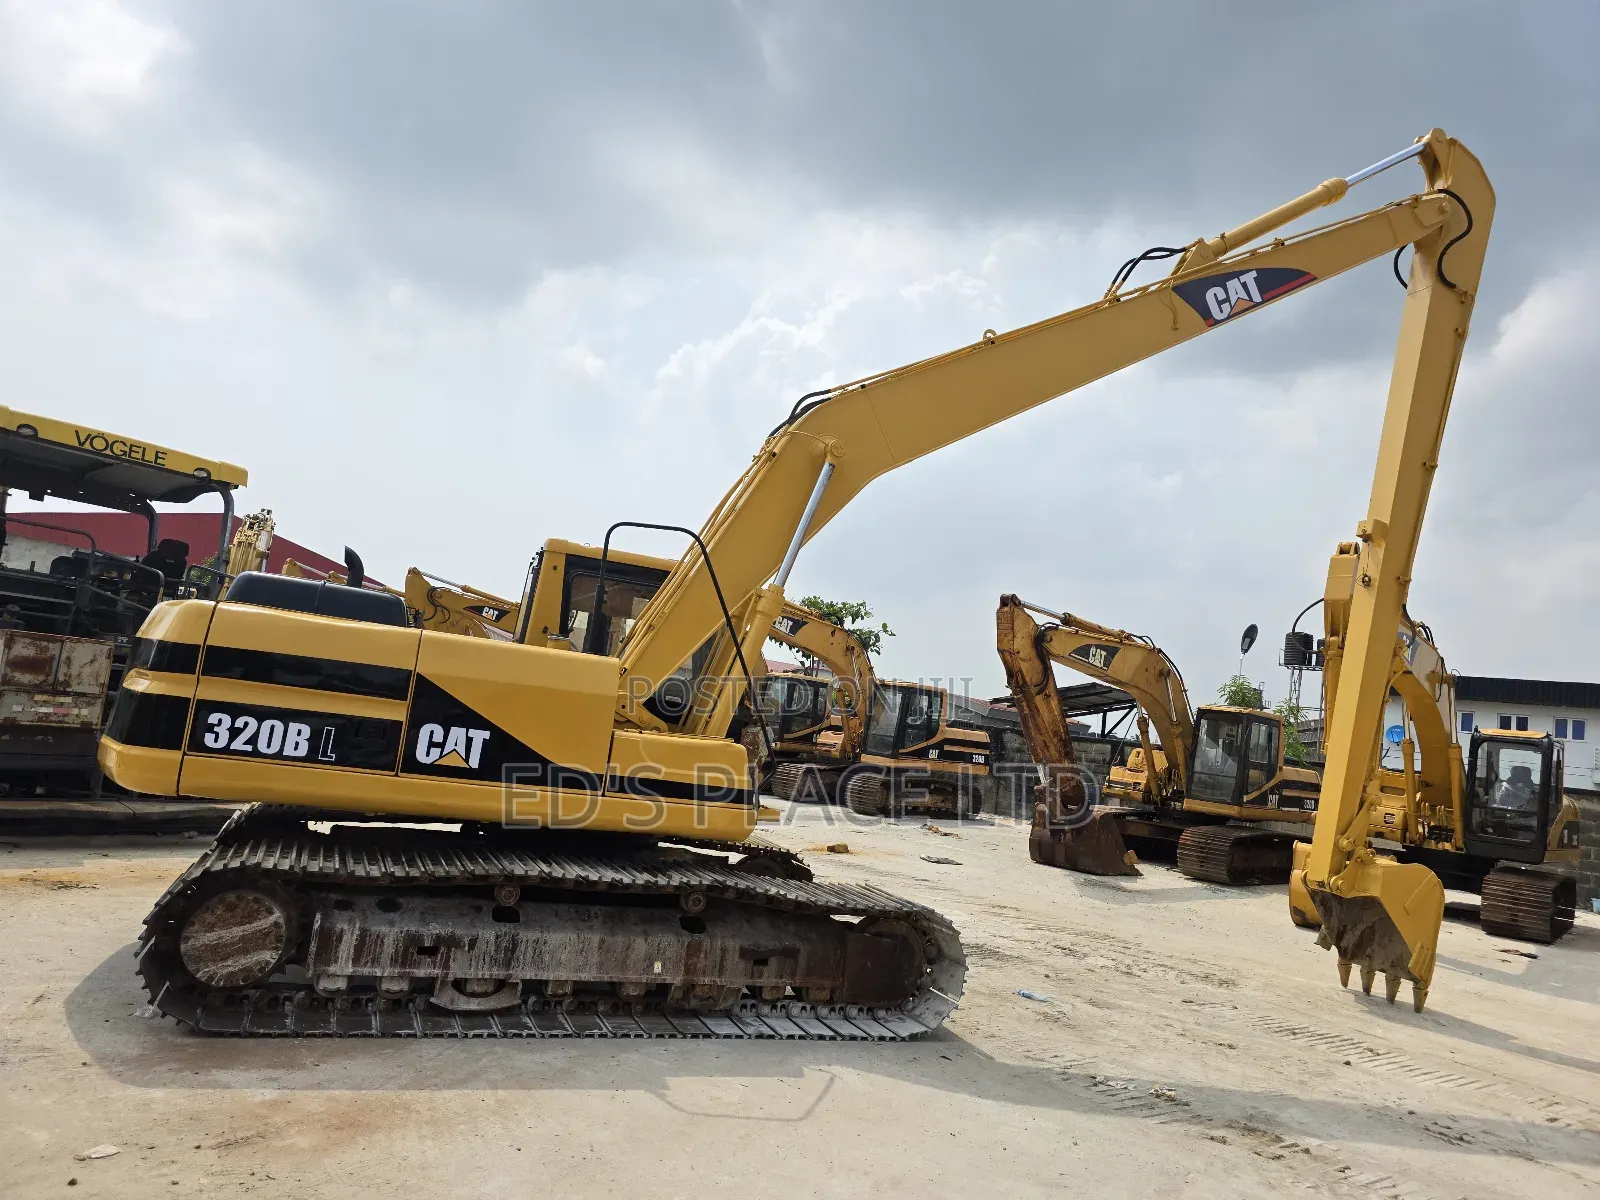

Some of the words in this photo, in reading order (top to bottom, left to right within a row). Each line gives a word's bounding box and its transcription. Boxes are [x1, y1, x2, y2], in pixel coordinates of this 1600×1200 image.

[1205, 270, 1263, 321] CAT
[74, 429, 168, 467] VÖGELE
[482, 606, 499, 621] CAT
[1088, 645, 1107, 668] CAT
[203, 712, 311, 757] 320B
[318, 726, 336, 761] L
[415, 723, 491, 769] CAT
